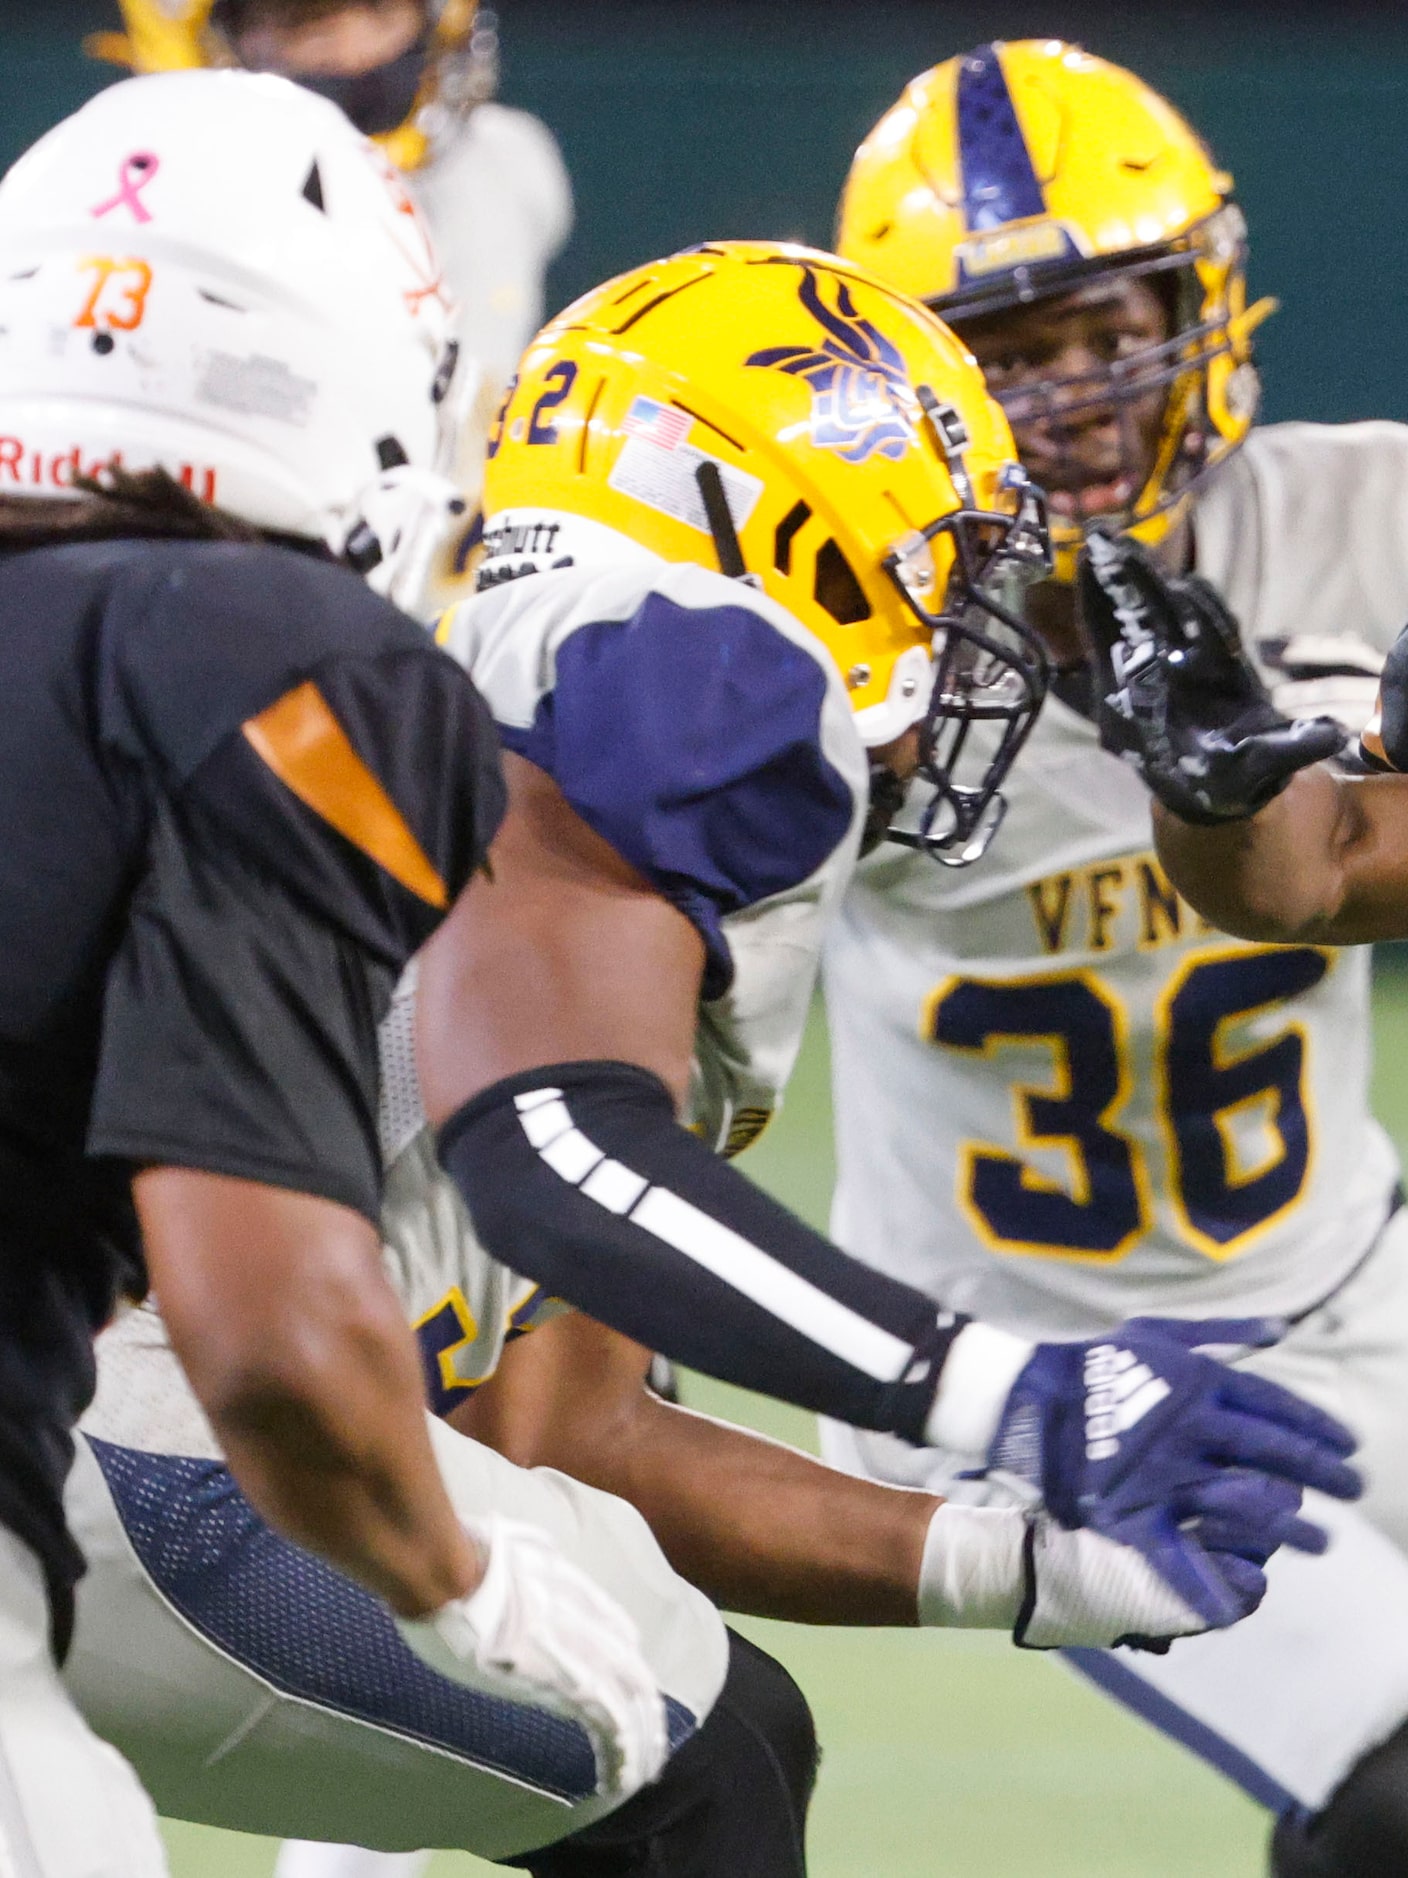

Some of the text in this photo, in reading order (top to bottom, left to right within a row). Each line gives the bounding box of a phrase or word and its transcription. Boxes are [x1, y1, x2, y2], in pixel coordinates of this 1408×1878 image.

[73, 254, 153, 331] 73
[0, 435, 216, 506] Riddll
[1026, 853, 1214, 954] VFN
[921, 943, 1338, 1264] 36
